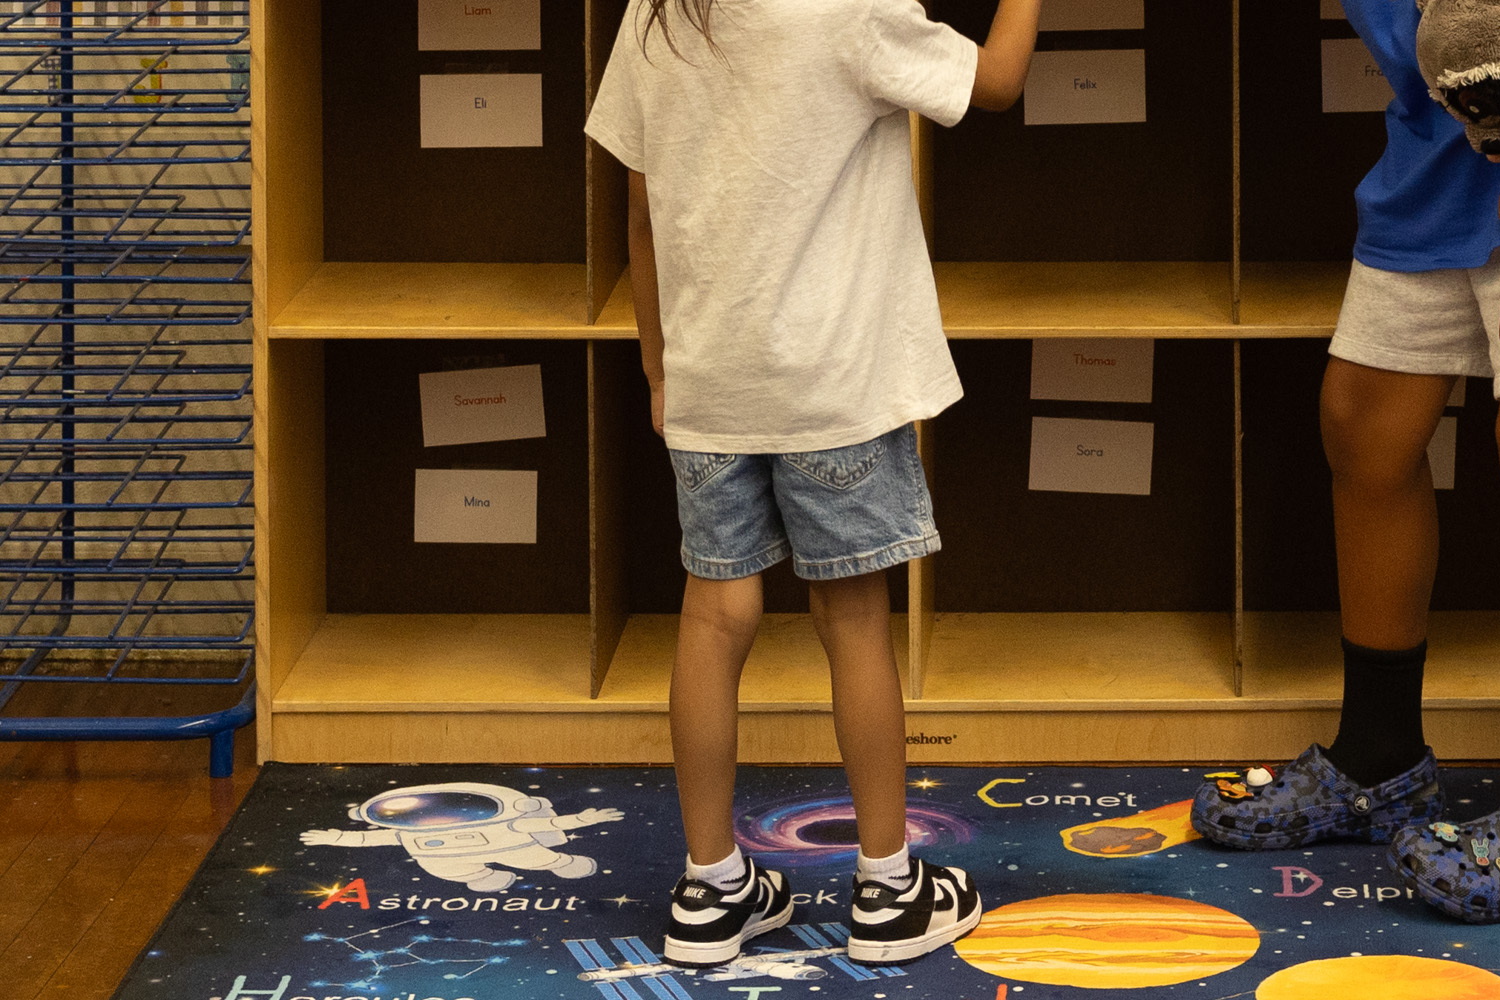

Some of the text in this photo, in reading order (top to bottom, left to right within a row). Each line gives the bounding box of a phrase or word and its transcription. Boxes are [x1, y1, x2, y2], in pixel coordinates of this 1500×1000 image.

[464, 4, 492, 16] Liam
[1364, 65, 1383, 77] Fra
[1073, 78, 1097, 90] Felix
[474, 97, 487, 109] Eli
[1073, 352, 1116, 366] Thomas
[454, 393, 507, 406] Savannah
[1076, 443, 1104, 457] Sora
[464, 496, 491, 508] Mina
[905, 732, 952, 745] eshore
[977, 778, 1138, 808] Comet
[317, 878, 580, 913] Astronaut
[682, 886, 706, 899] NIKE
[860, 887, 881, 899] NIKE
